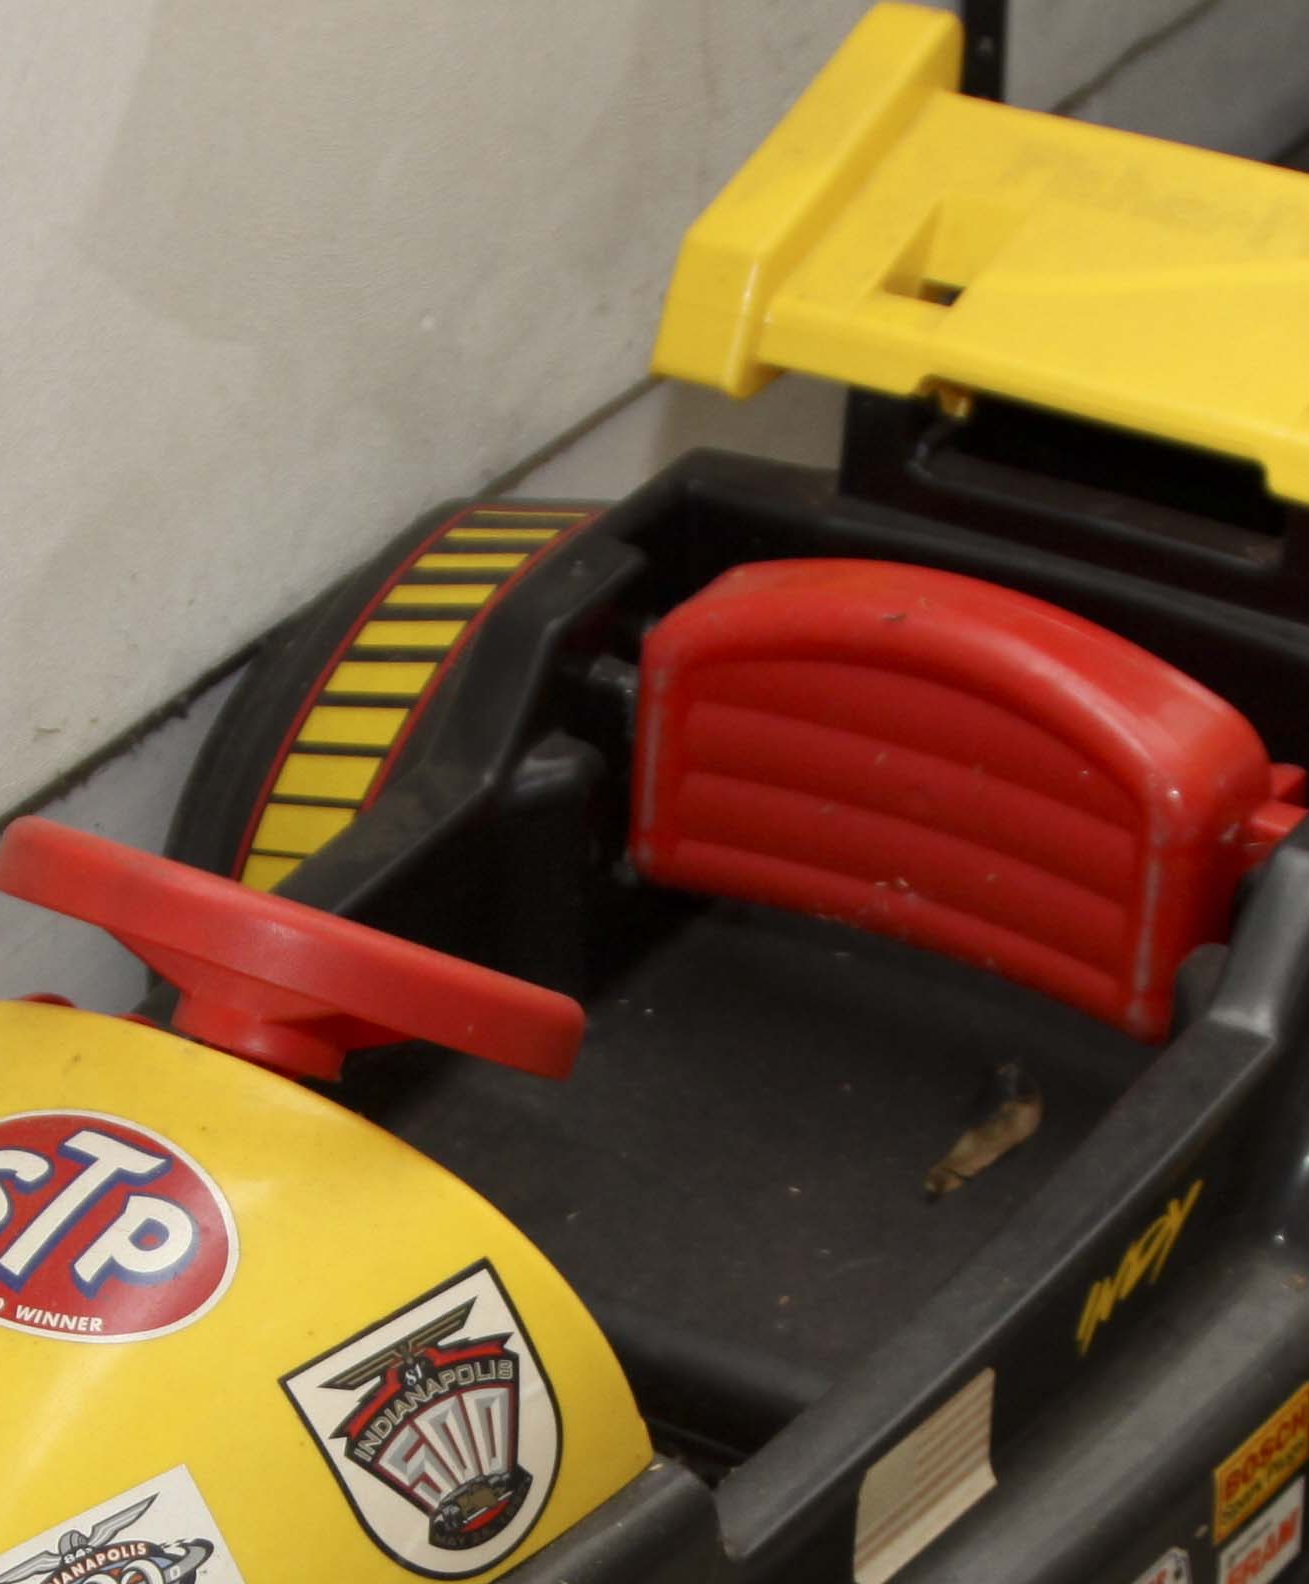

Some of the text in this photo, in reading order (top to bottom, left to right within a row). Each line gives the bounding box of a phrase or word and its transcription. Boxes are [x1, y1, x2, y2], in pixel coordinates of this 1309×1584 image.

[15, 1304, 103, 1333] WINNER
[1076, 1179, 1204, 1360] INDY
[353, 1358, 515, 1461] INDIANAPOLIS
[377, 1386, 512, 1510] 500
